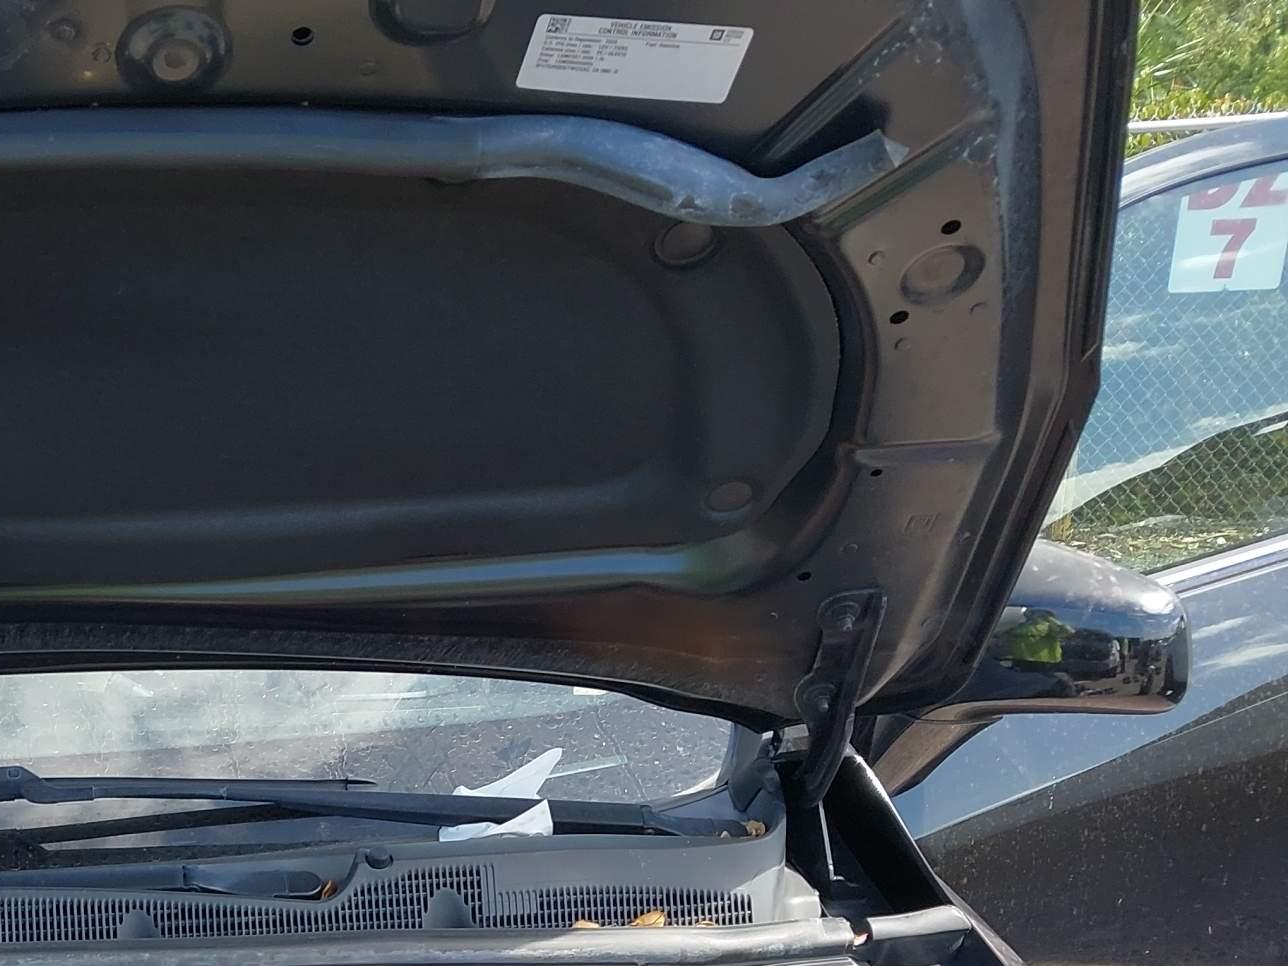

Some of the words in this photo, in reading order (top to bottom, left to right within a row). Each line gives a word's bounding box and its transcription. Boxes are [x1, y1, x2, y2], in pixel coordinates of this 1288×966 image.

[598, 27, 628, 36] CONTROL
[631, 30, 678, 38] INFORMATION
[1209, 217, 1258, 280] 7
